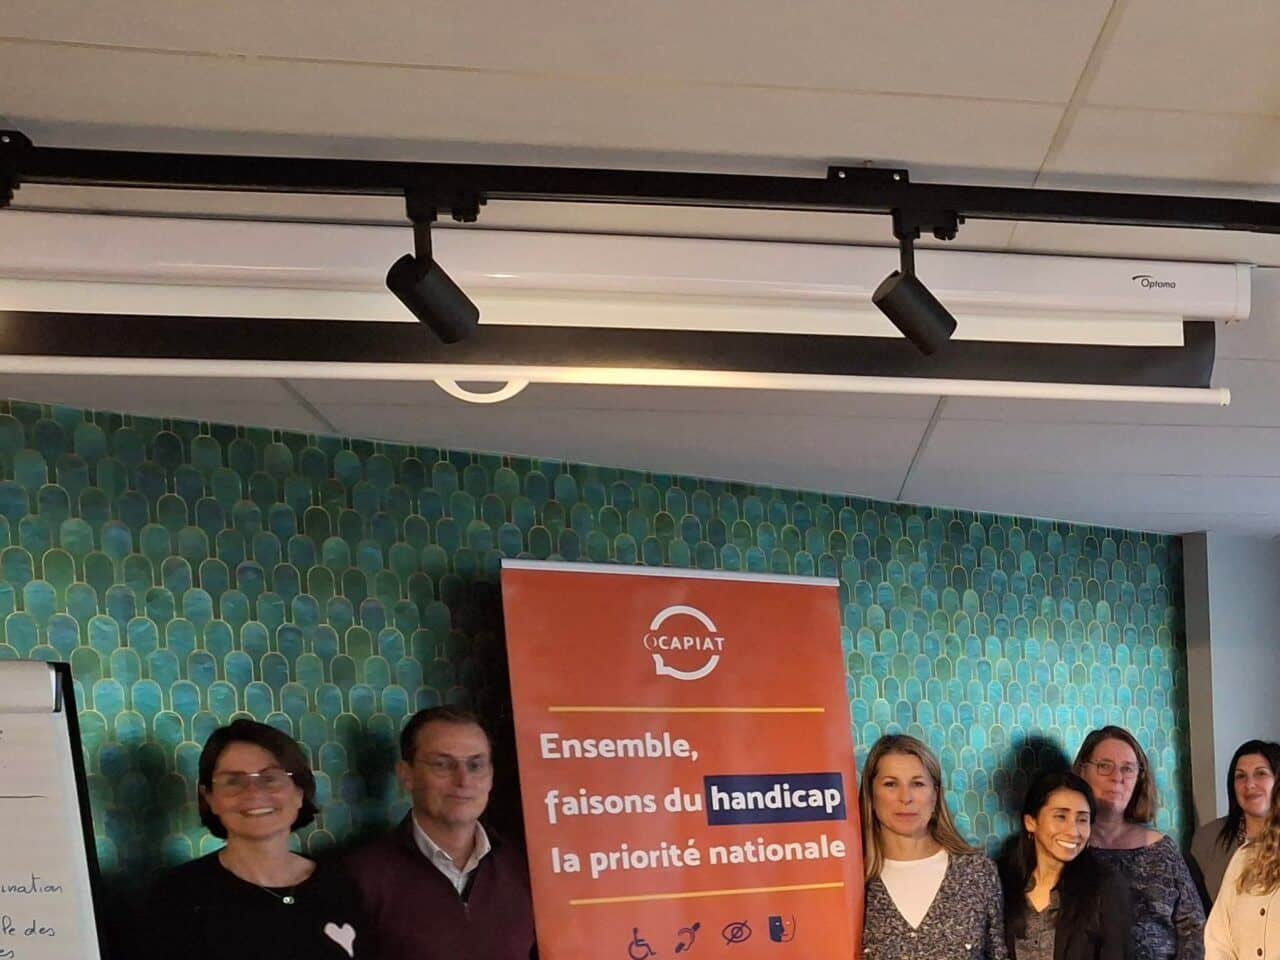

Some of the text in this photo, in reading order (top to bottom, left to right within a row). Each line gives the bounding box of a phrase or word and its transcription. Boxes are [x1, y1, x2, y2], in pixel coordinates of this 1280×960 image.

[1141, 278, 1176, 290] Optoma
[643, 633, 725, 652] OCAPIAT
[539, 732, 699, 762] Ensemble,
[544, 783, 842, 824] faisons du handicap
[551, 834, 847, 879] la priorité nationale
